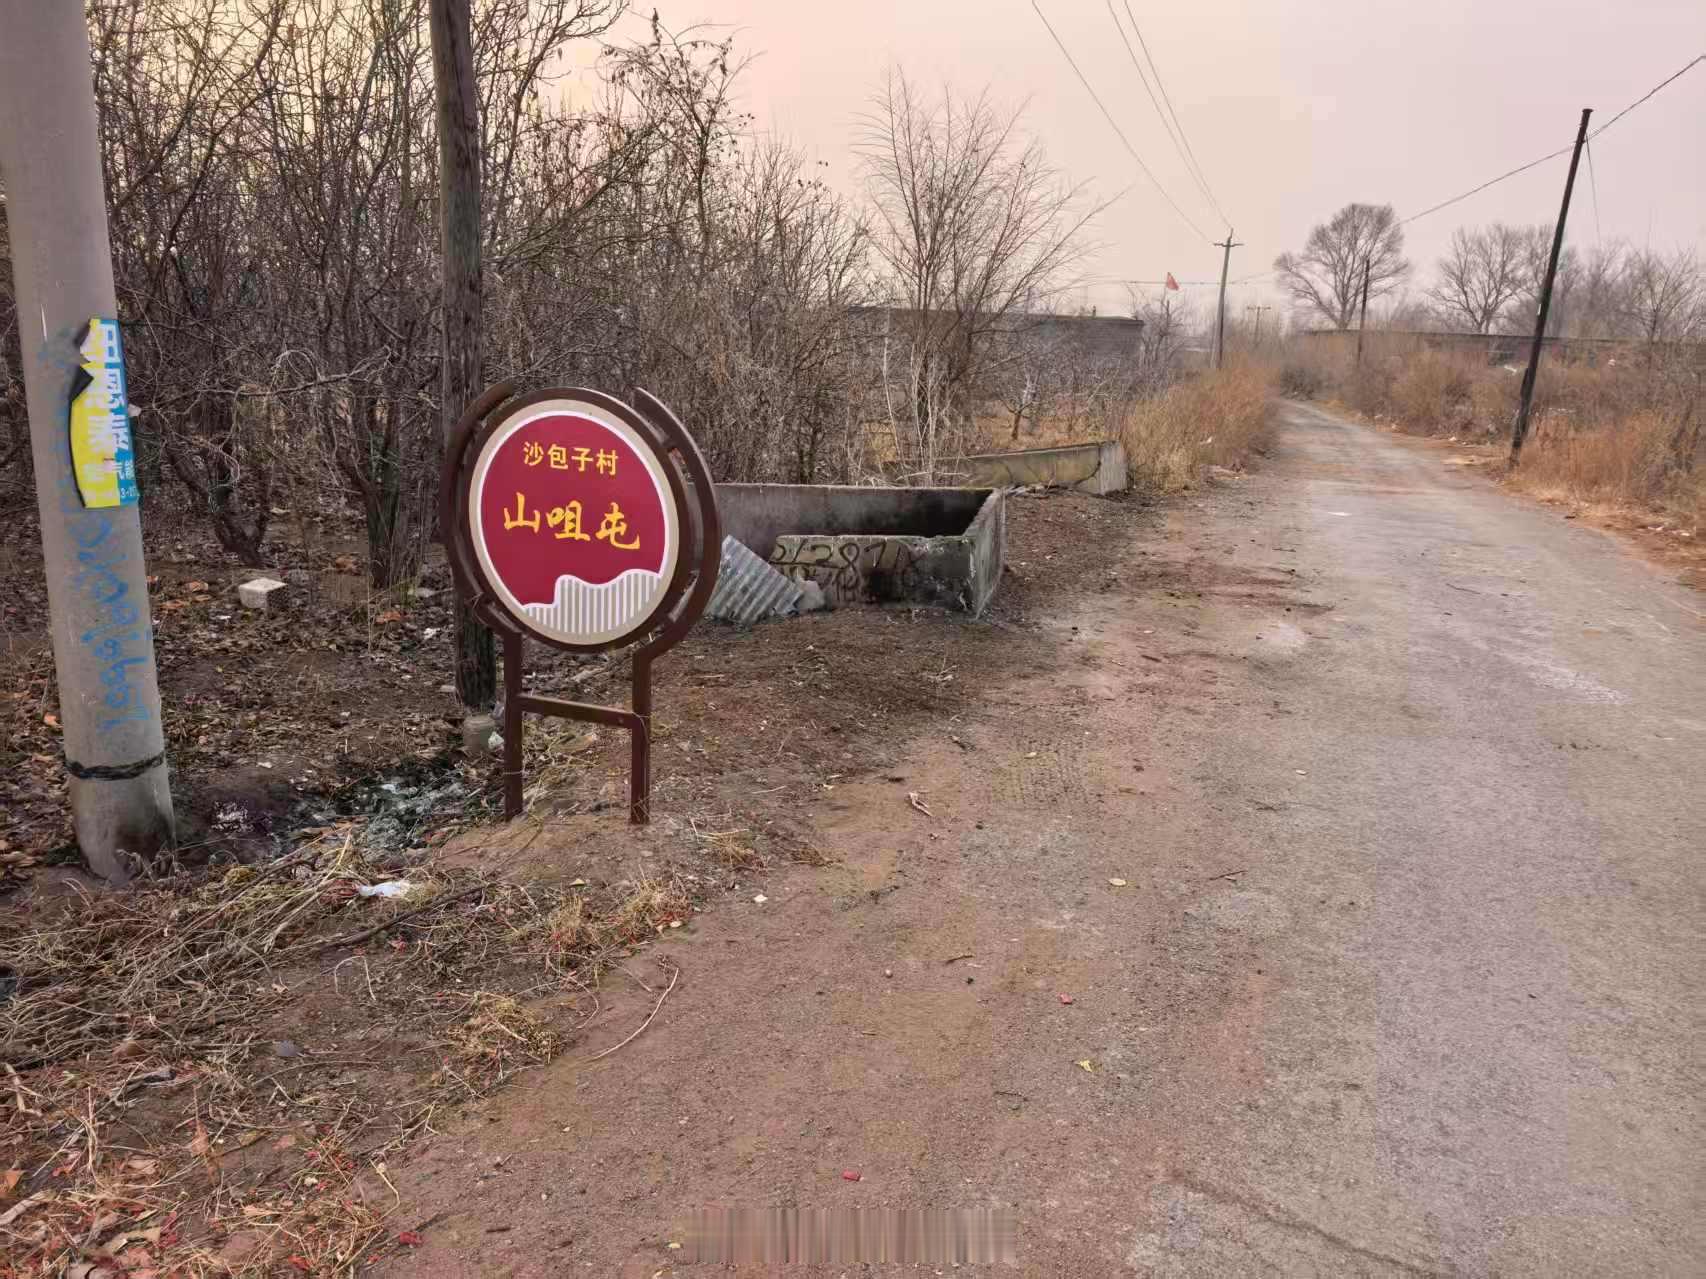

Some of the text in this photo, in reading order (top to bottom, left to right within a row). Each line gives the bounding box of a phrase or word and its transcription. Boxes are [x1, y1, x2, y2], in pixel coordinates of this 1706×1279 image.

[522, 441, 619, 476] 沙包子村
[503, 492, 641, 550] 山咀屯
